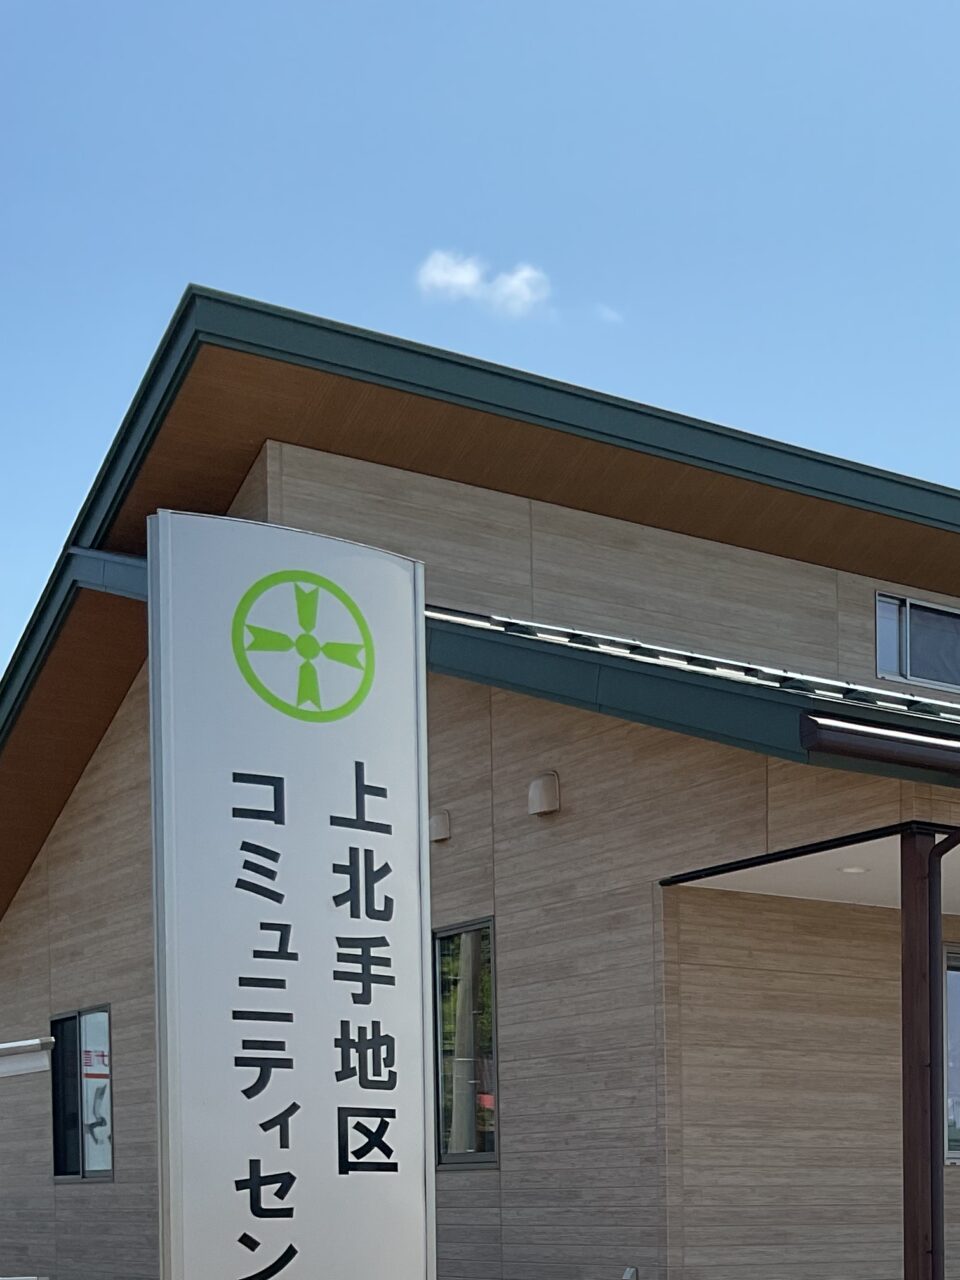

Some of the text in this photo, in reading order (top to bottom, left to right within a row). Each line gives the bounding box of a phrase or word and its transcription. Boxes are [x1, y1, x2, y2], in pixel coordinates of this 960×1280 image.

[329, 760, 399, 1176] 上北手地区
